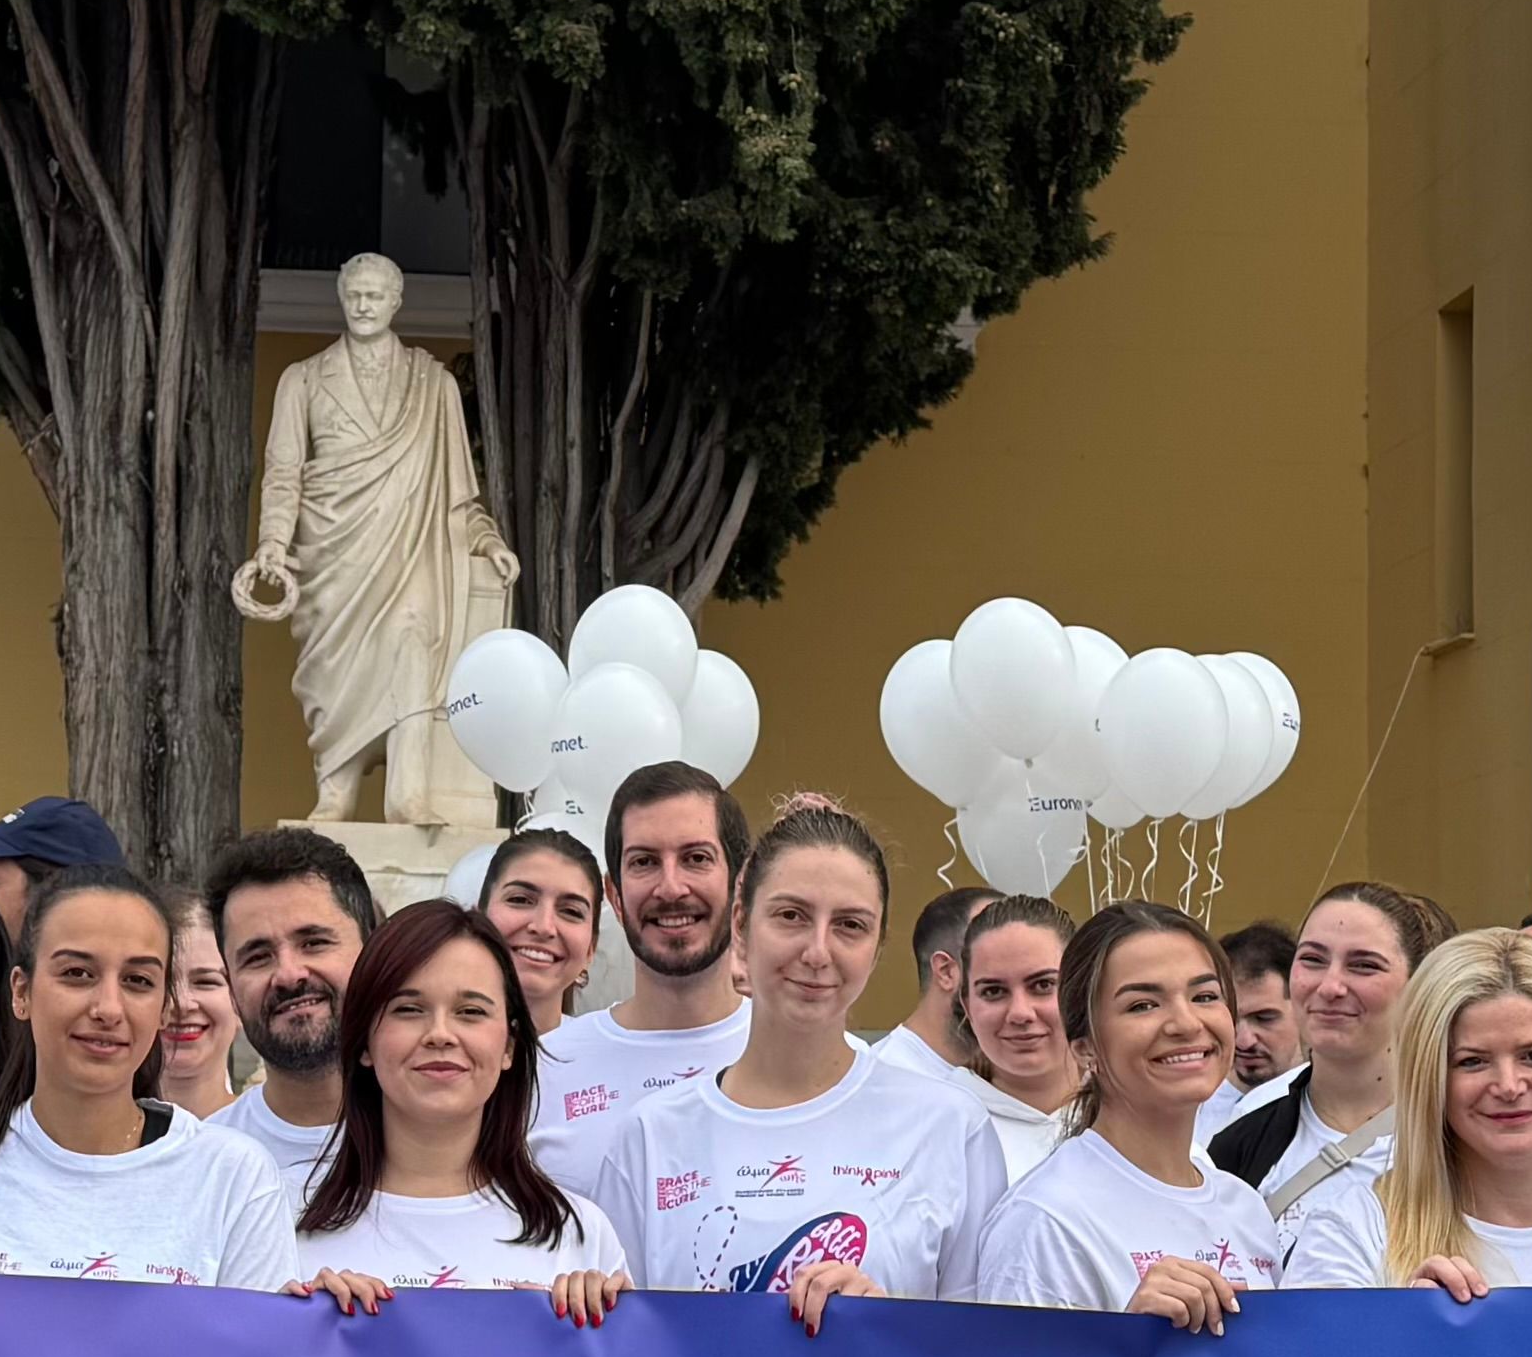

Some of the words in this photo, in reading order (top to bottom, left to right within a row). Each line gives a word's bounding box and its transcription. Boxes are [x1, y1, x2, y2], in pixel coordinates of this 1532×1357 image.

[1028, 797, 1083, 812] Euron
[666, 1170, 699, 1187] RACE
[832, 1165, 864, 1177] think
[873, 1167, 900, 1179] pink
